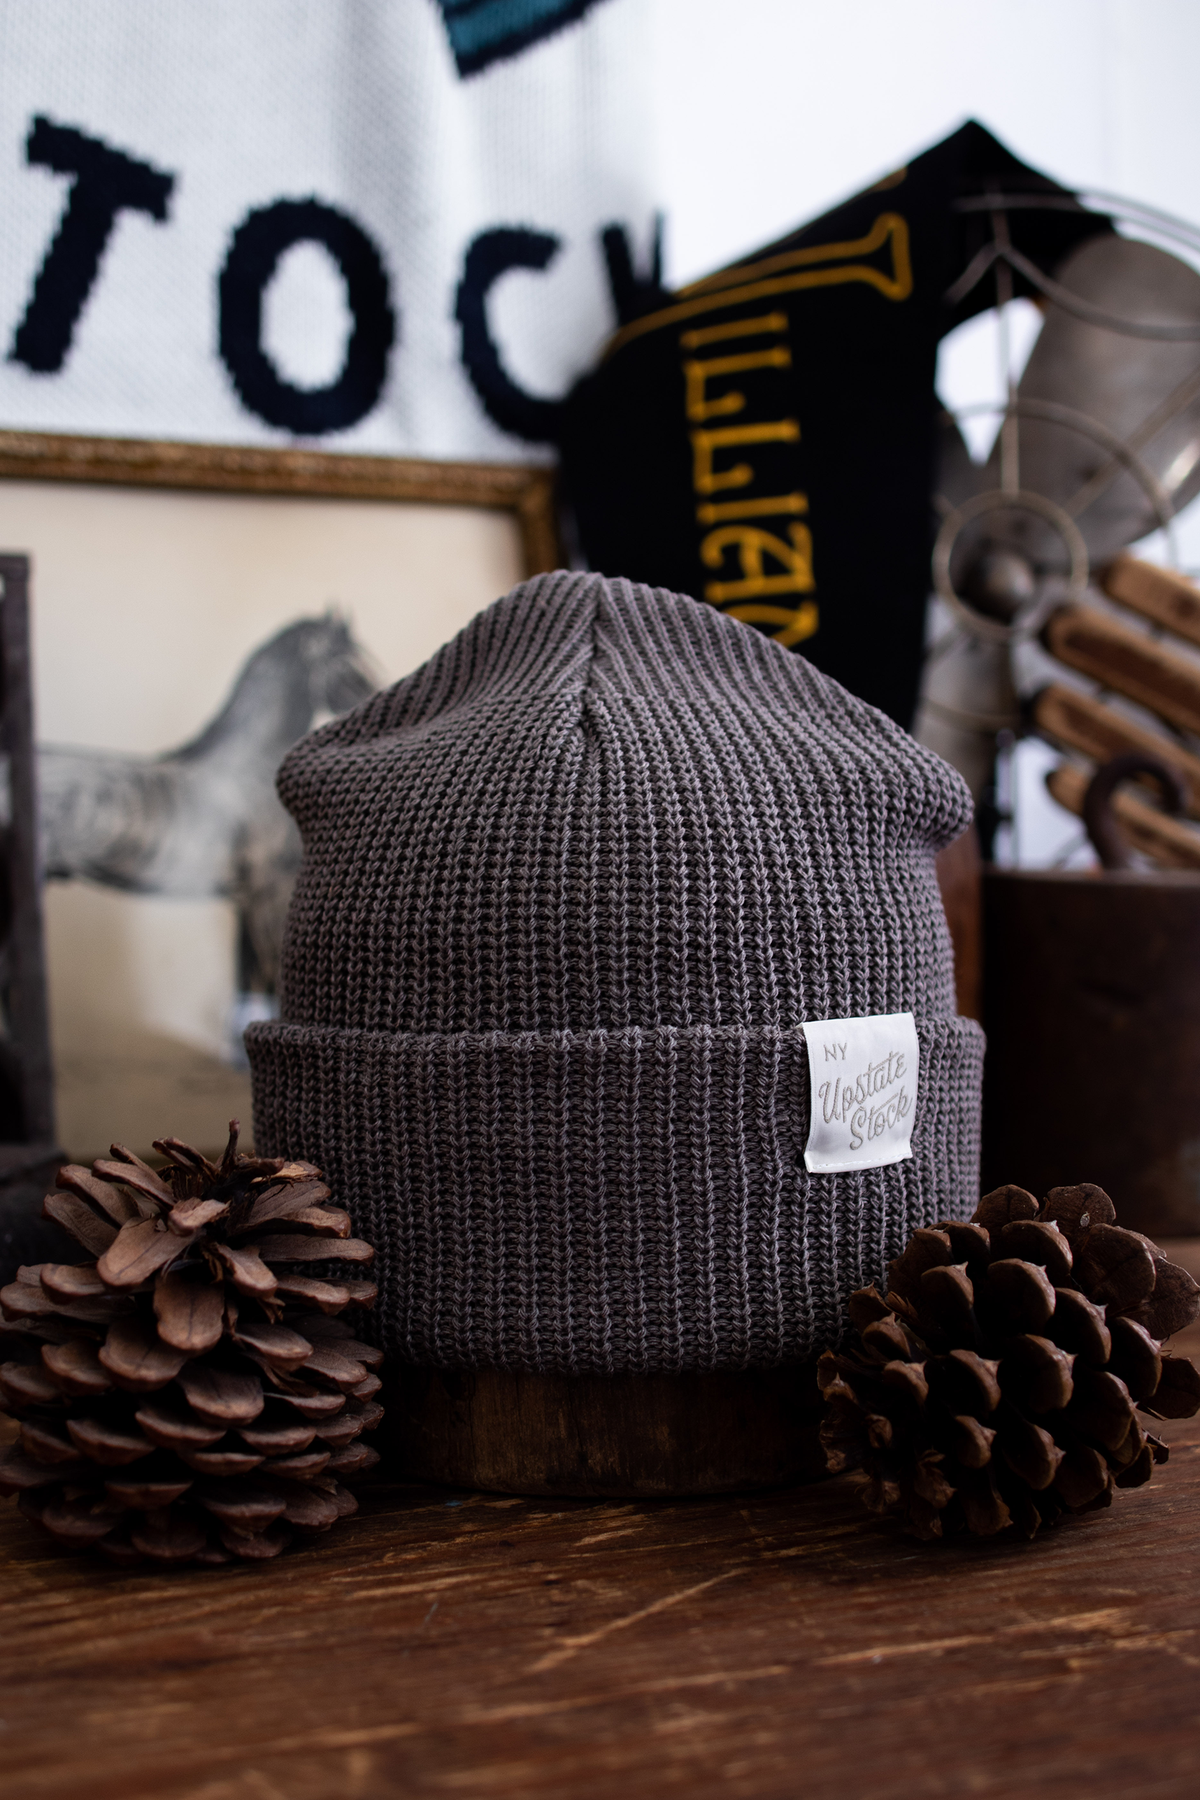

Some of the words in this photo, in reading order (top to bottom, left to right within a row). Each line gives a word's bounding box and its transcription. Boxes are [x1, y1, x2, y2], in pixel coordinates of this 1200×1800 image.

[823, 1042, 848, 1062] NY
[818, 1050, 908, 1124] Upstate
[849, 1085, 913, 1150] Stock
